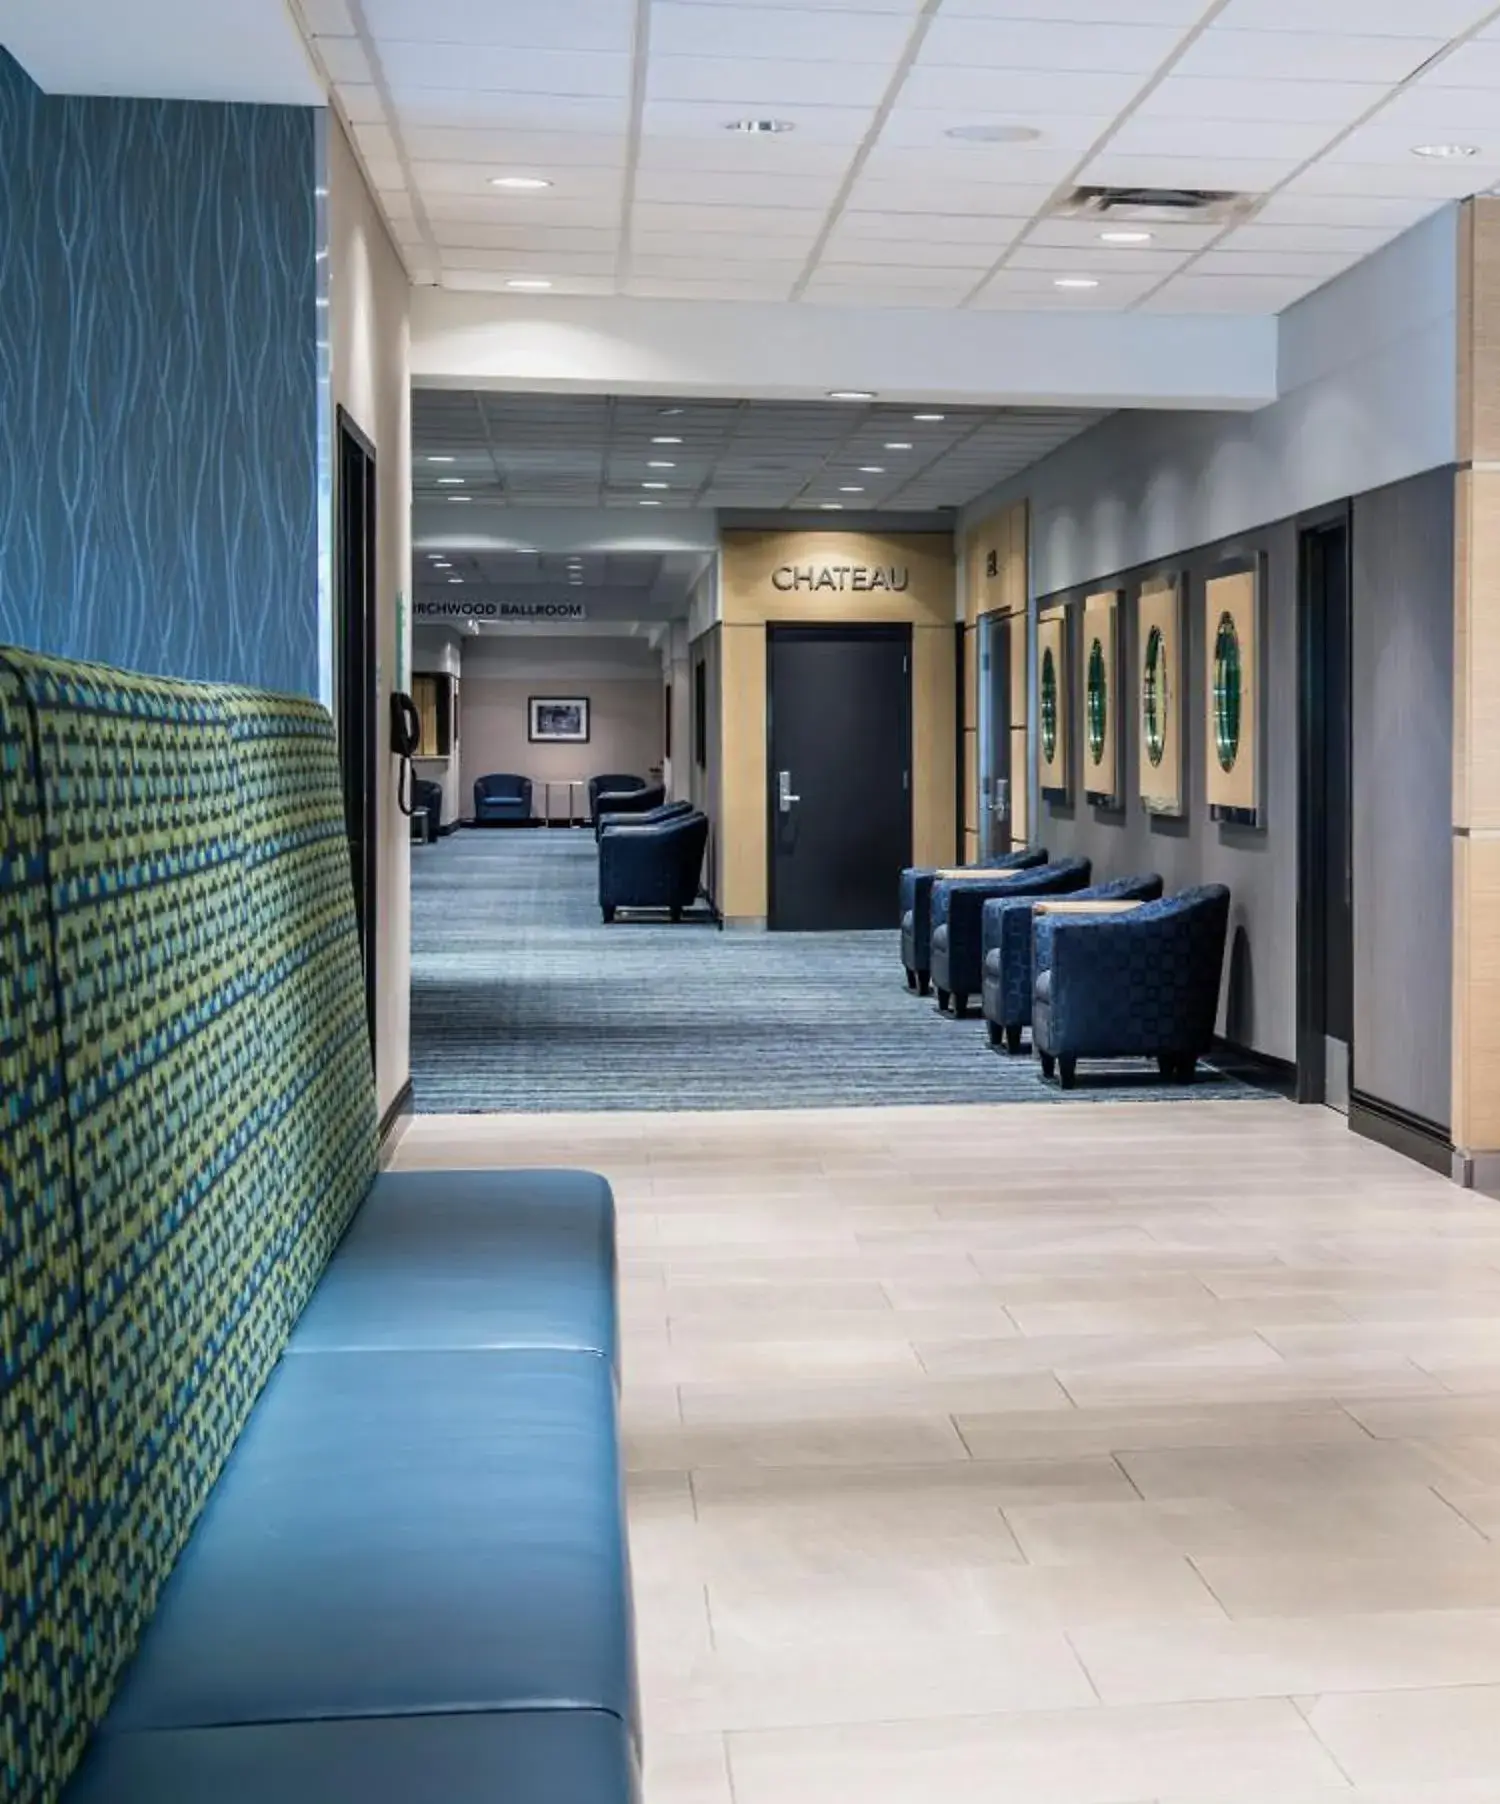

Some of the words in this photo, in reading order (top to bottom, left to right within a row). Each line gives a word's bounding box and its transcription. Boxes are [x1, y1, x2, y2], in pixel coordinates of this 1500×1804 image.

[771, 566, 909, 592] CHATEAU
[412, 602, 496, 616] IRCHWOOD
[501, 602, 582, 616] BALLROOM
